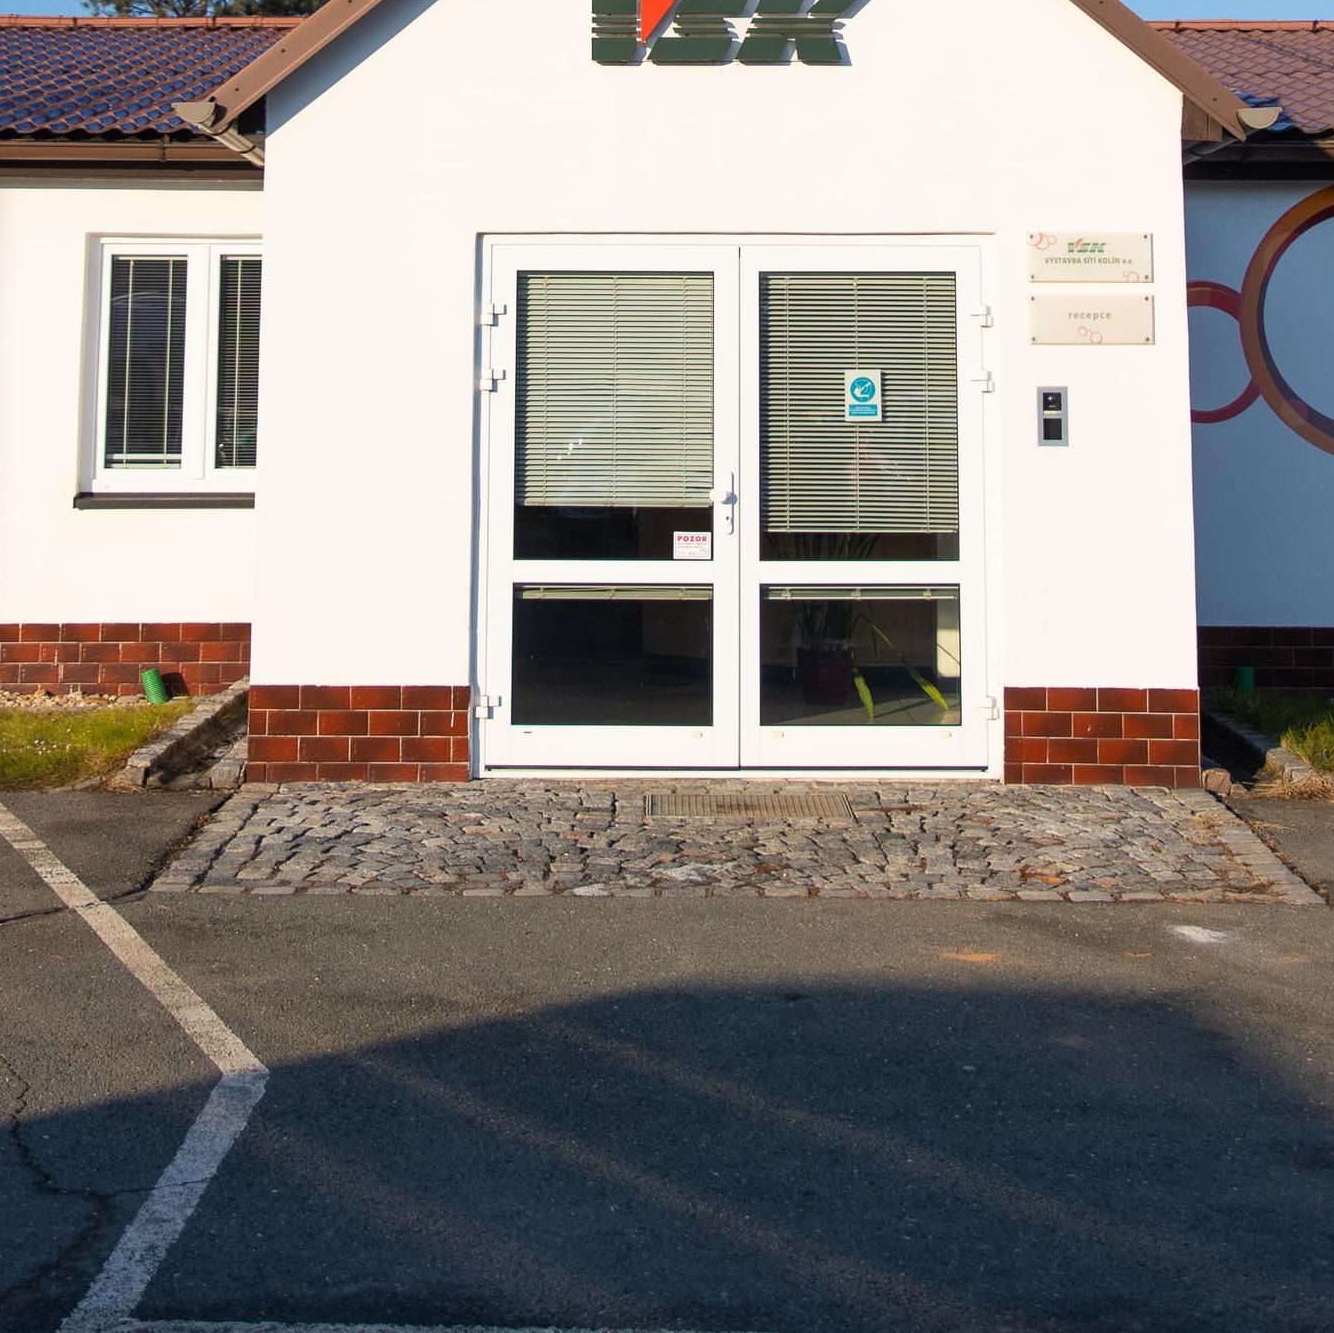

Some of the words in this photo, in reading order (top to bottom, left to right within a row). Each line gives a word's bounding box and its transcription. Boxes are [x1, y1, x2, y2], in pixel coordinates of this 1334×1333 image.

[1044, 256, 1081, 264] VÝSTAVBA
[1083, 255, 1096, 264] SÍTÍ
[1097, 255, 1120, 264] KOLÍN
[1068, 312, 1112, 320] recepce
